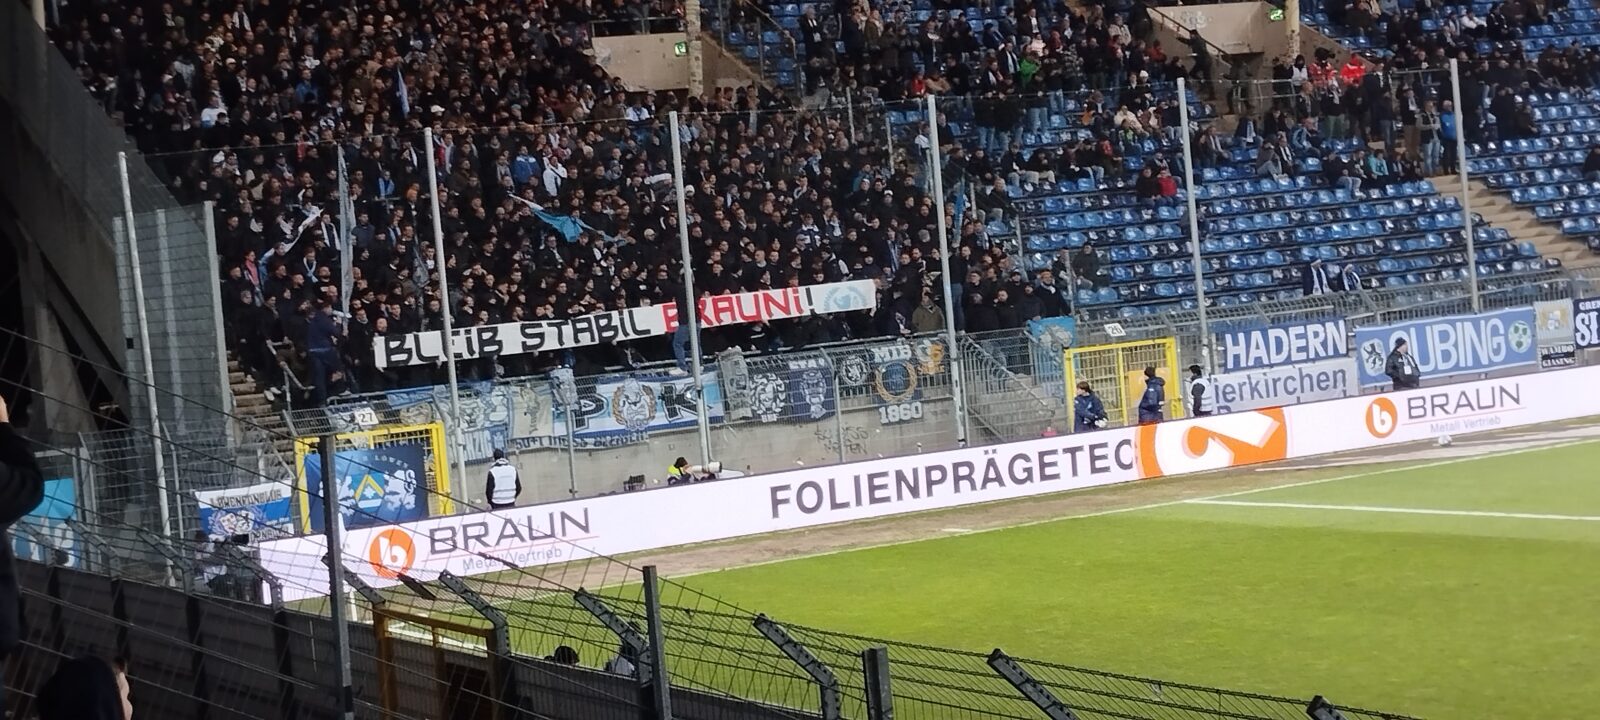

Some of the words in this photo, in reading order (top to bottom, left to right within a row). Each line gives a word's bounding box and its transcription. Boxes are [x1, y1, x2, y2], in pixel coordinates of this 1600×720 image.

[1225, 320, 1348, 369] HADERN
[1214, 367, 1347, 404] ierkirchen
[879, 401, 923, 425] 1860
[1408, 383, 1520, 420] BRAUN
[358, 412, 374, 423] 27
[1464, 416, 1501, 429] Vertrieb
[429, 508, 591, 555] BRAUN
[509, 547, 562, 567] Vertrieb
